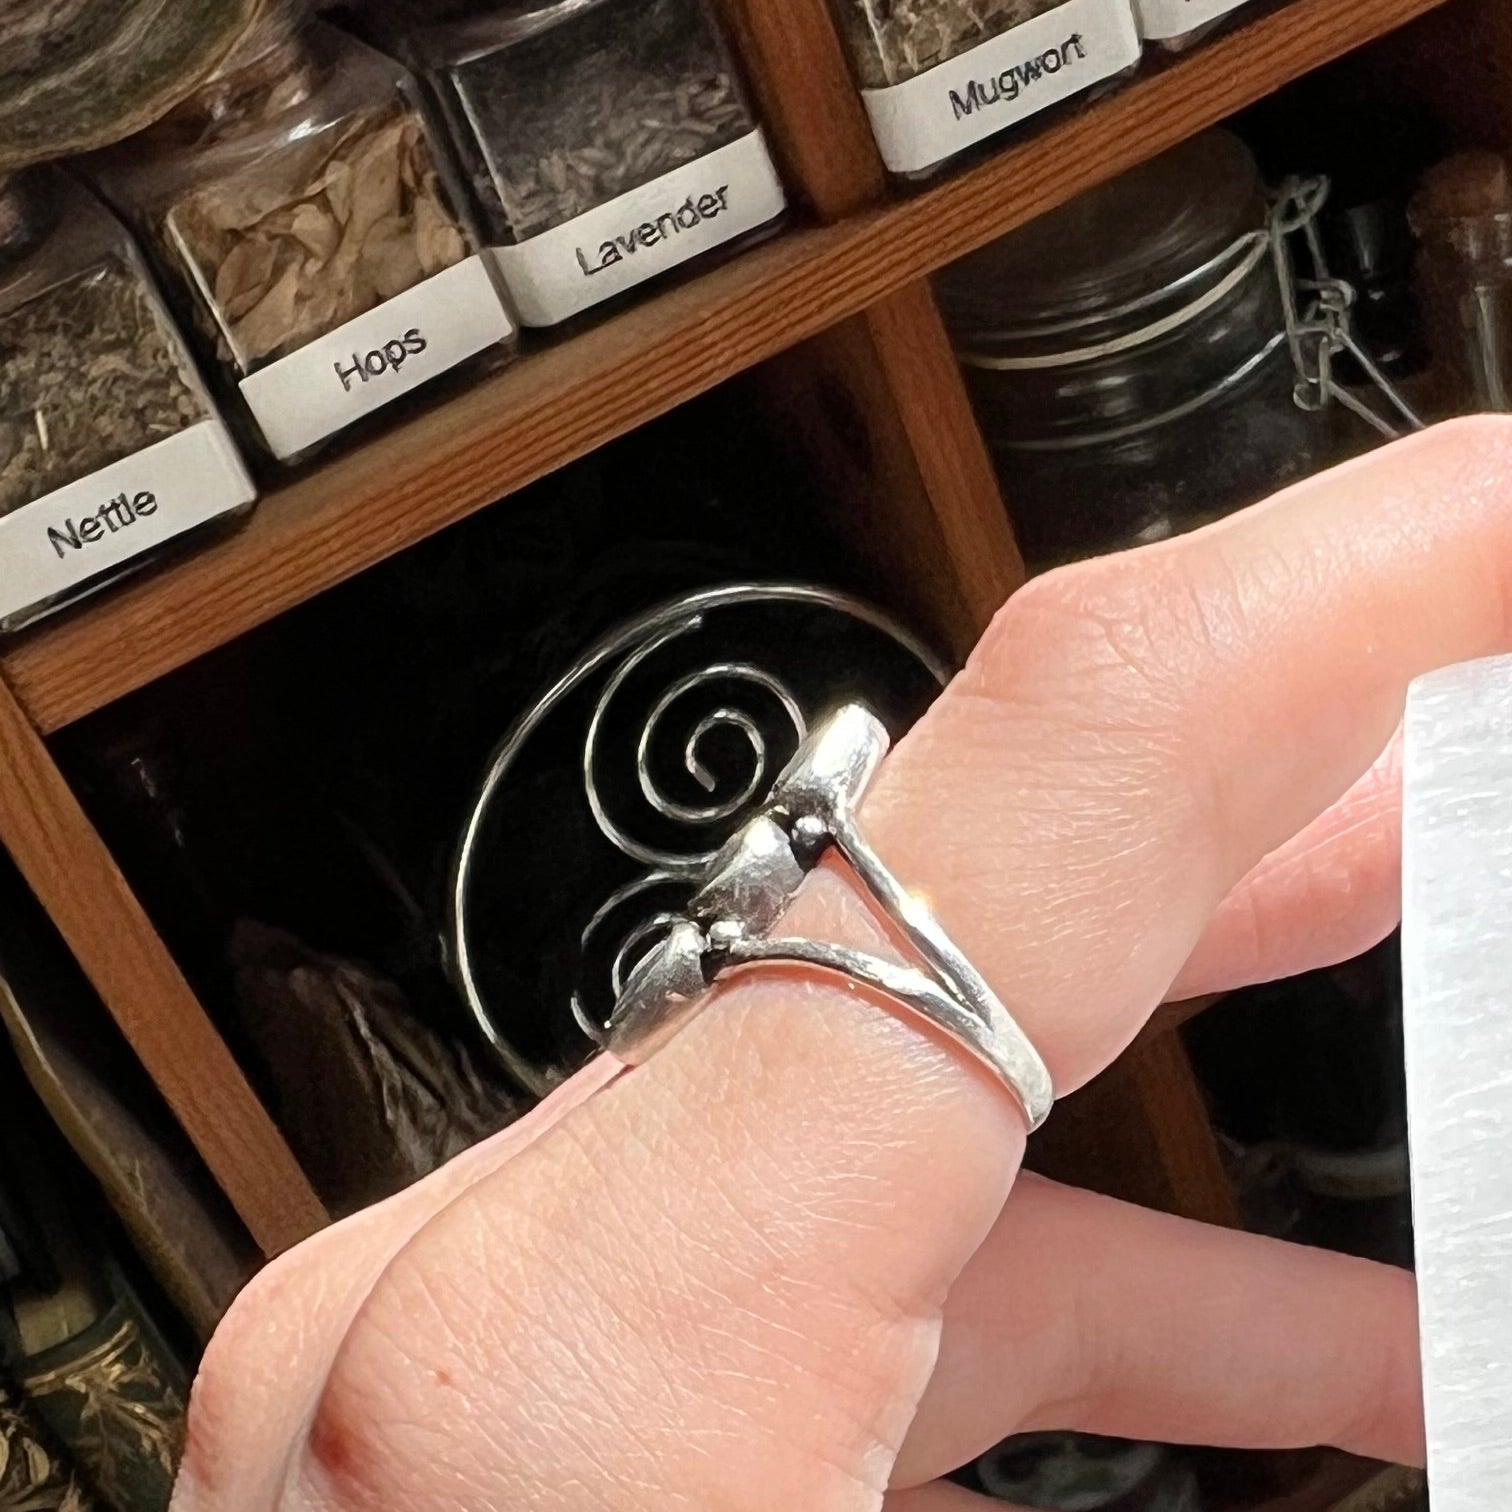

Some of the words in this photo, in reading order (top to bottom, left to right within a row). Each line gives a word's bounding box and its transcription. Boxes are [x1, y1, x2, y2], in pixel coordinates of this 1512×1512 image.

[949, 33, 1087, 120] Mugwort
[575, 184, 729, 276] Lavender
[333, 328, 427, 392] Hops
[47, 491, 158, 559] Nettle
